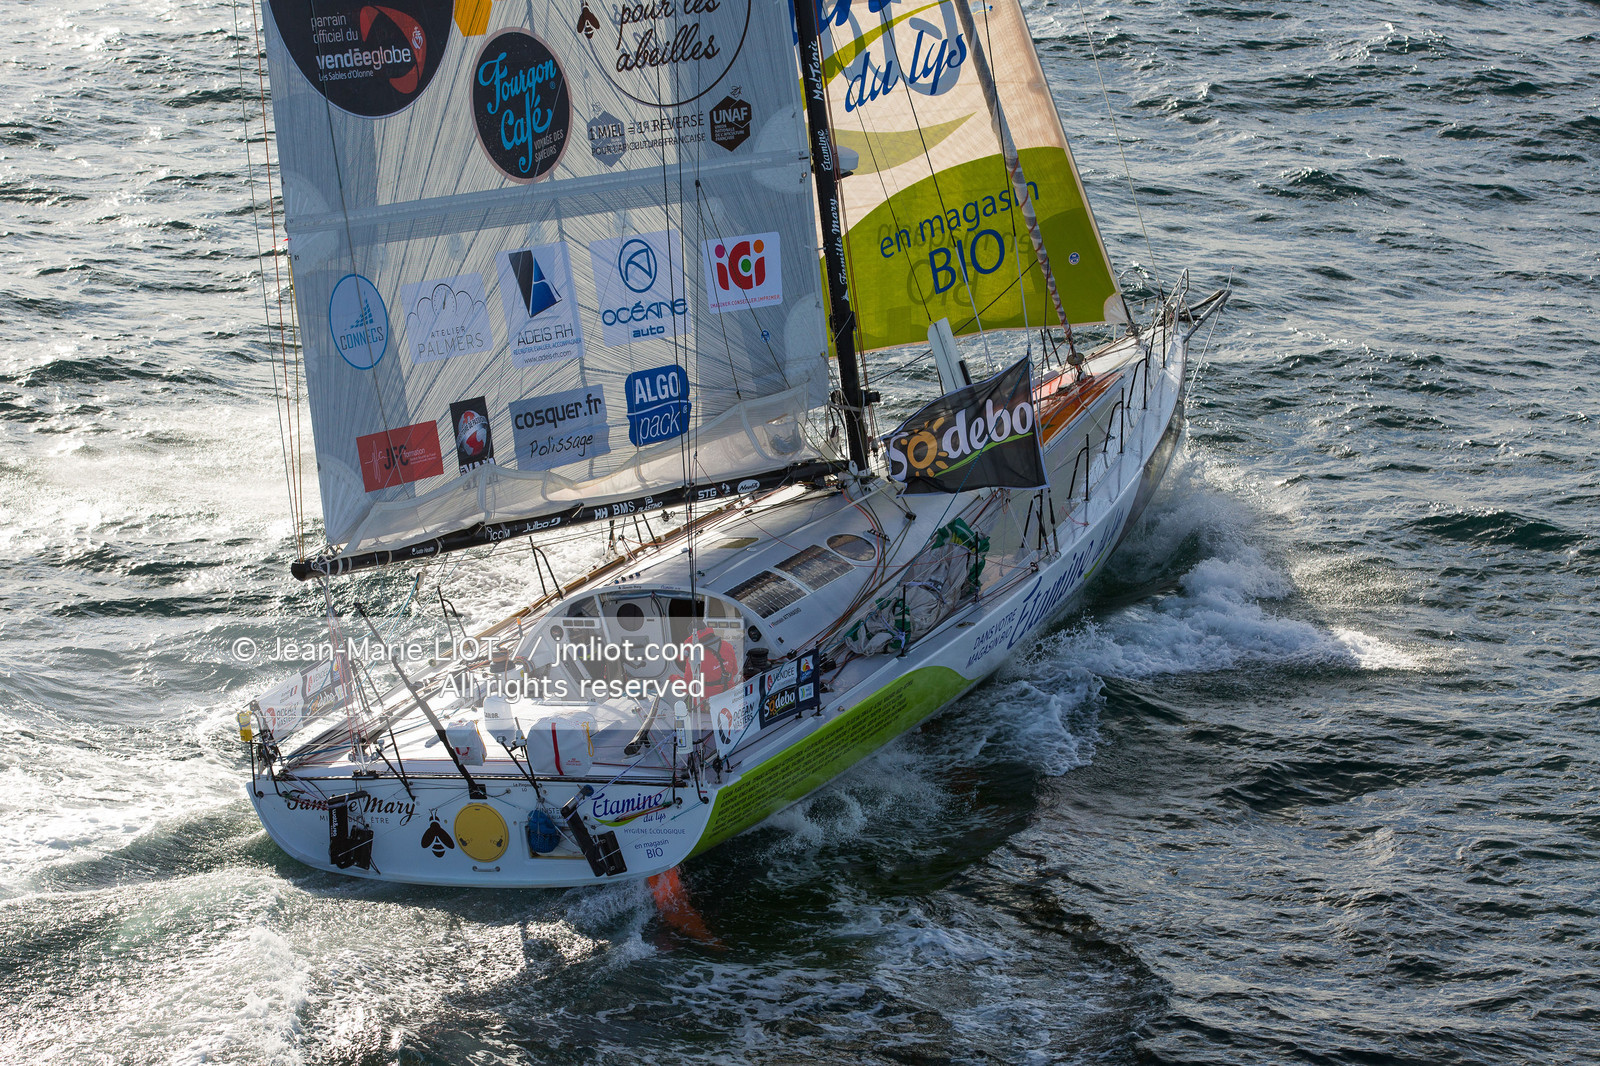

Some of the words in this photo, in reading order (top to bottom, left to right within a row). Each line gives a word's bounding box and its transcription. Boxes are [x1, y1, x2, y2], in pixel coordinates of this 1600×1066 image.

[311, 13, 347, 31] parrain
[616, 1, 674, 50] pour
[313, 28, 344, 44] officiel
[346, 28, 358, 42] du
[616, 23, 720, 72] abeilles
[328, 71, 347, 81] Sables
[348, 70, 374, 80] d'Olonne
[478, 52, 556, 114] Fourgon
[845, 51, 899, 112] du
[909, 30, 968, 95] lys
[598, 124, 625, 139] MIEL
[653, 111, 705, 132] REVERSÉ
[713, 107, 748, 124] UNAF
[501, 92, 552, 173] Café
[553, 129, 564, 142] DES
[880, 229, 911, 258] en
[929, 229, 1005, 294] BIO
[602, 298, 688, 326] OCÉANE
[340, 327, 384, 350] CONNECS
[431, 326, 466, 338] ATELIER
[555, 323, 574, 339] RH
[633, 325, 665, 338] auto
[418, 332, 484, 358] PALMERS
[635, 372, 679, 404] ALGO
[514, 393, 602, 430] cosquer.fr
[640, 406, 680, 443] pack
[530, 433, 593, 459] Polissage
[889, 399, 1033, 481] Sodebo
[384, 445, 409, 470] JFC
[698, 488, 717, 499] STG
[613, 501, 635, 515] BMS
[363, 797, 416, 826] Mary
[591, 793, 662, 817] Étamine
[643, 814, 653, 822] du
[656, 812, 666, 823] lys
[644, 839, 669, 848] magasin
[646, 847, 664, 859] BIO
